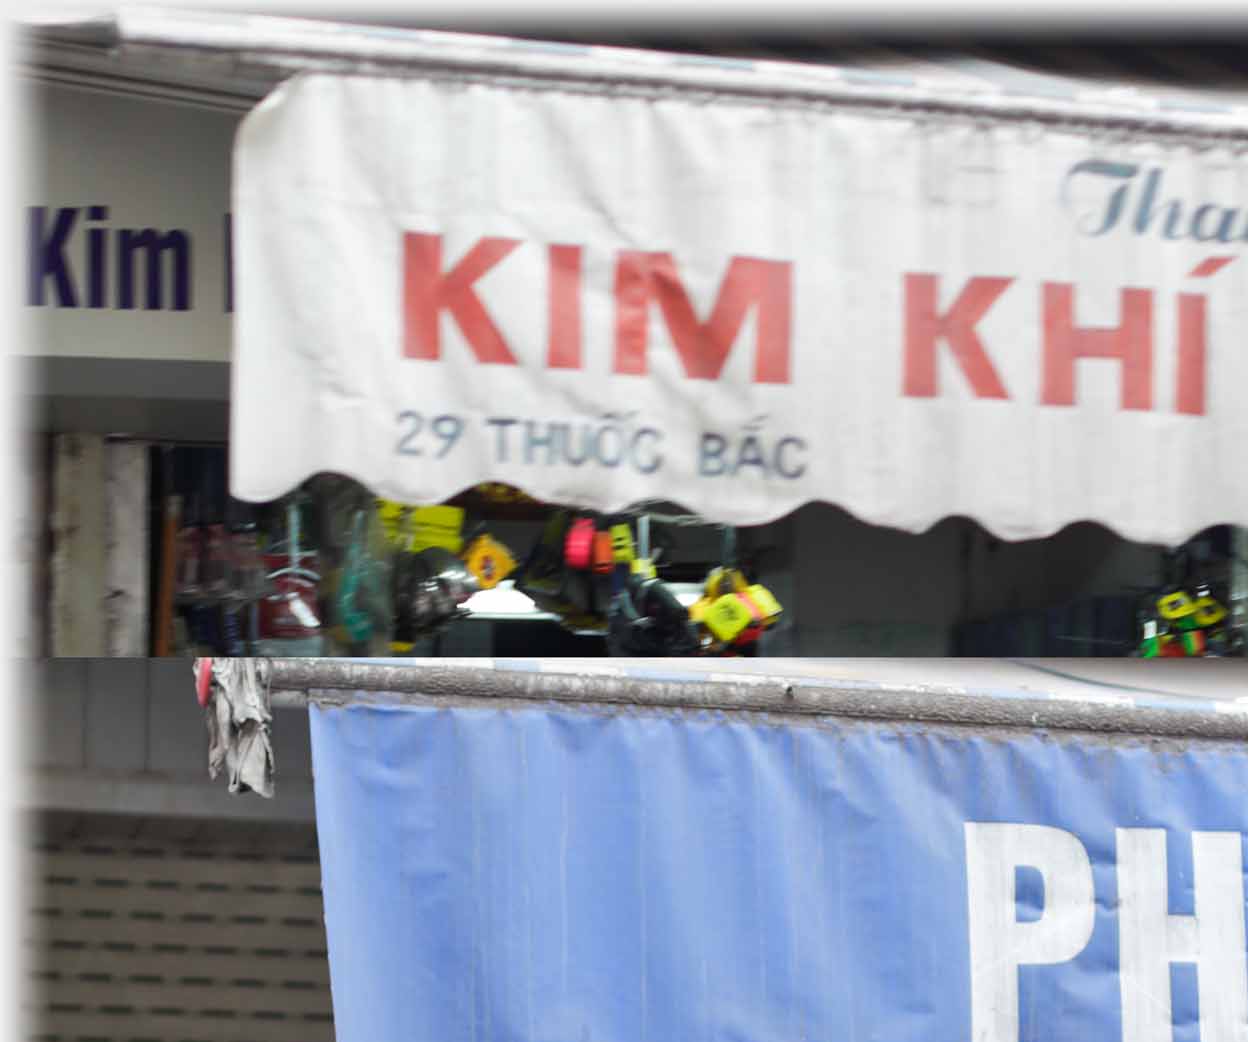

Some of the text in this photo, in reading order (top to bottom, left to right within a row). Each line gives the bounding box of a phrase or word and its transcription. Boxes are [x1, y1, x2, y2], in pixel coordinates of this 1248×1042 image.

[25, 205, 193, 311] Kim
[402, 231, 794, 385] KIM
[900, 257, 1238, 417] KHÍ
[394, 410, 465, 459] 29
[699, 415, 808, 480] BẮC
